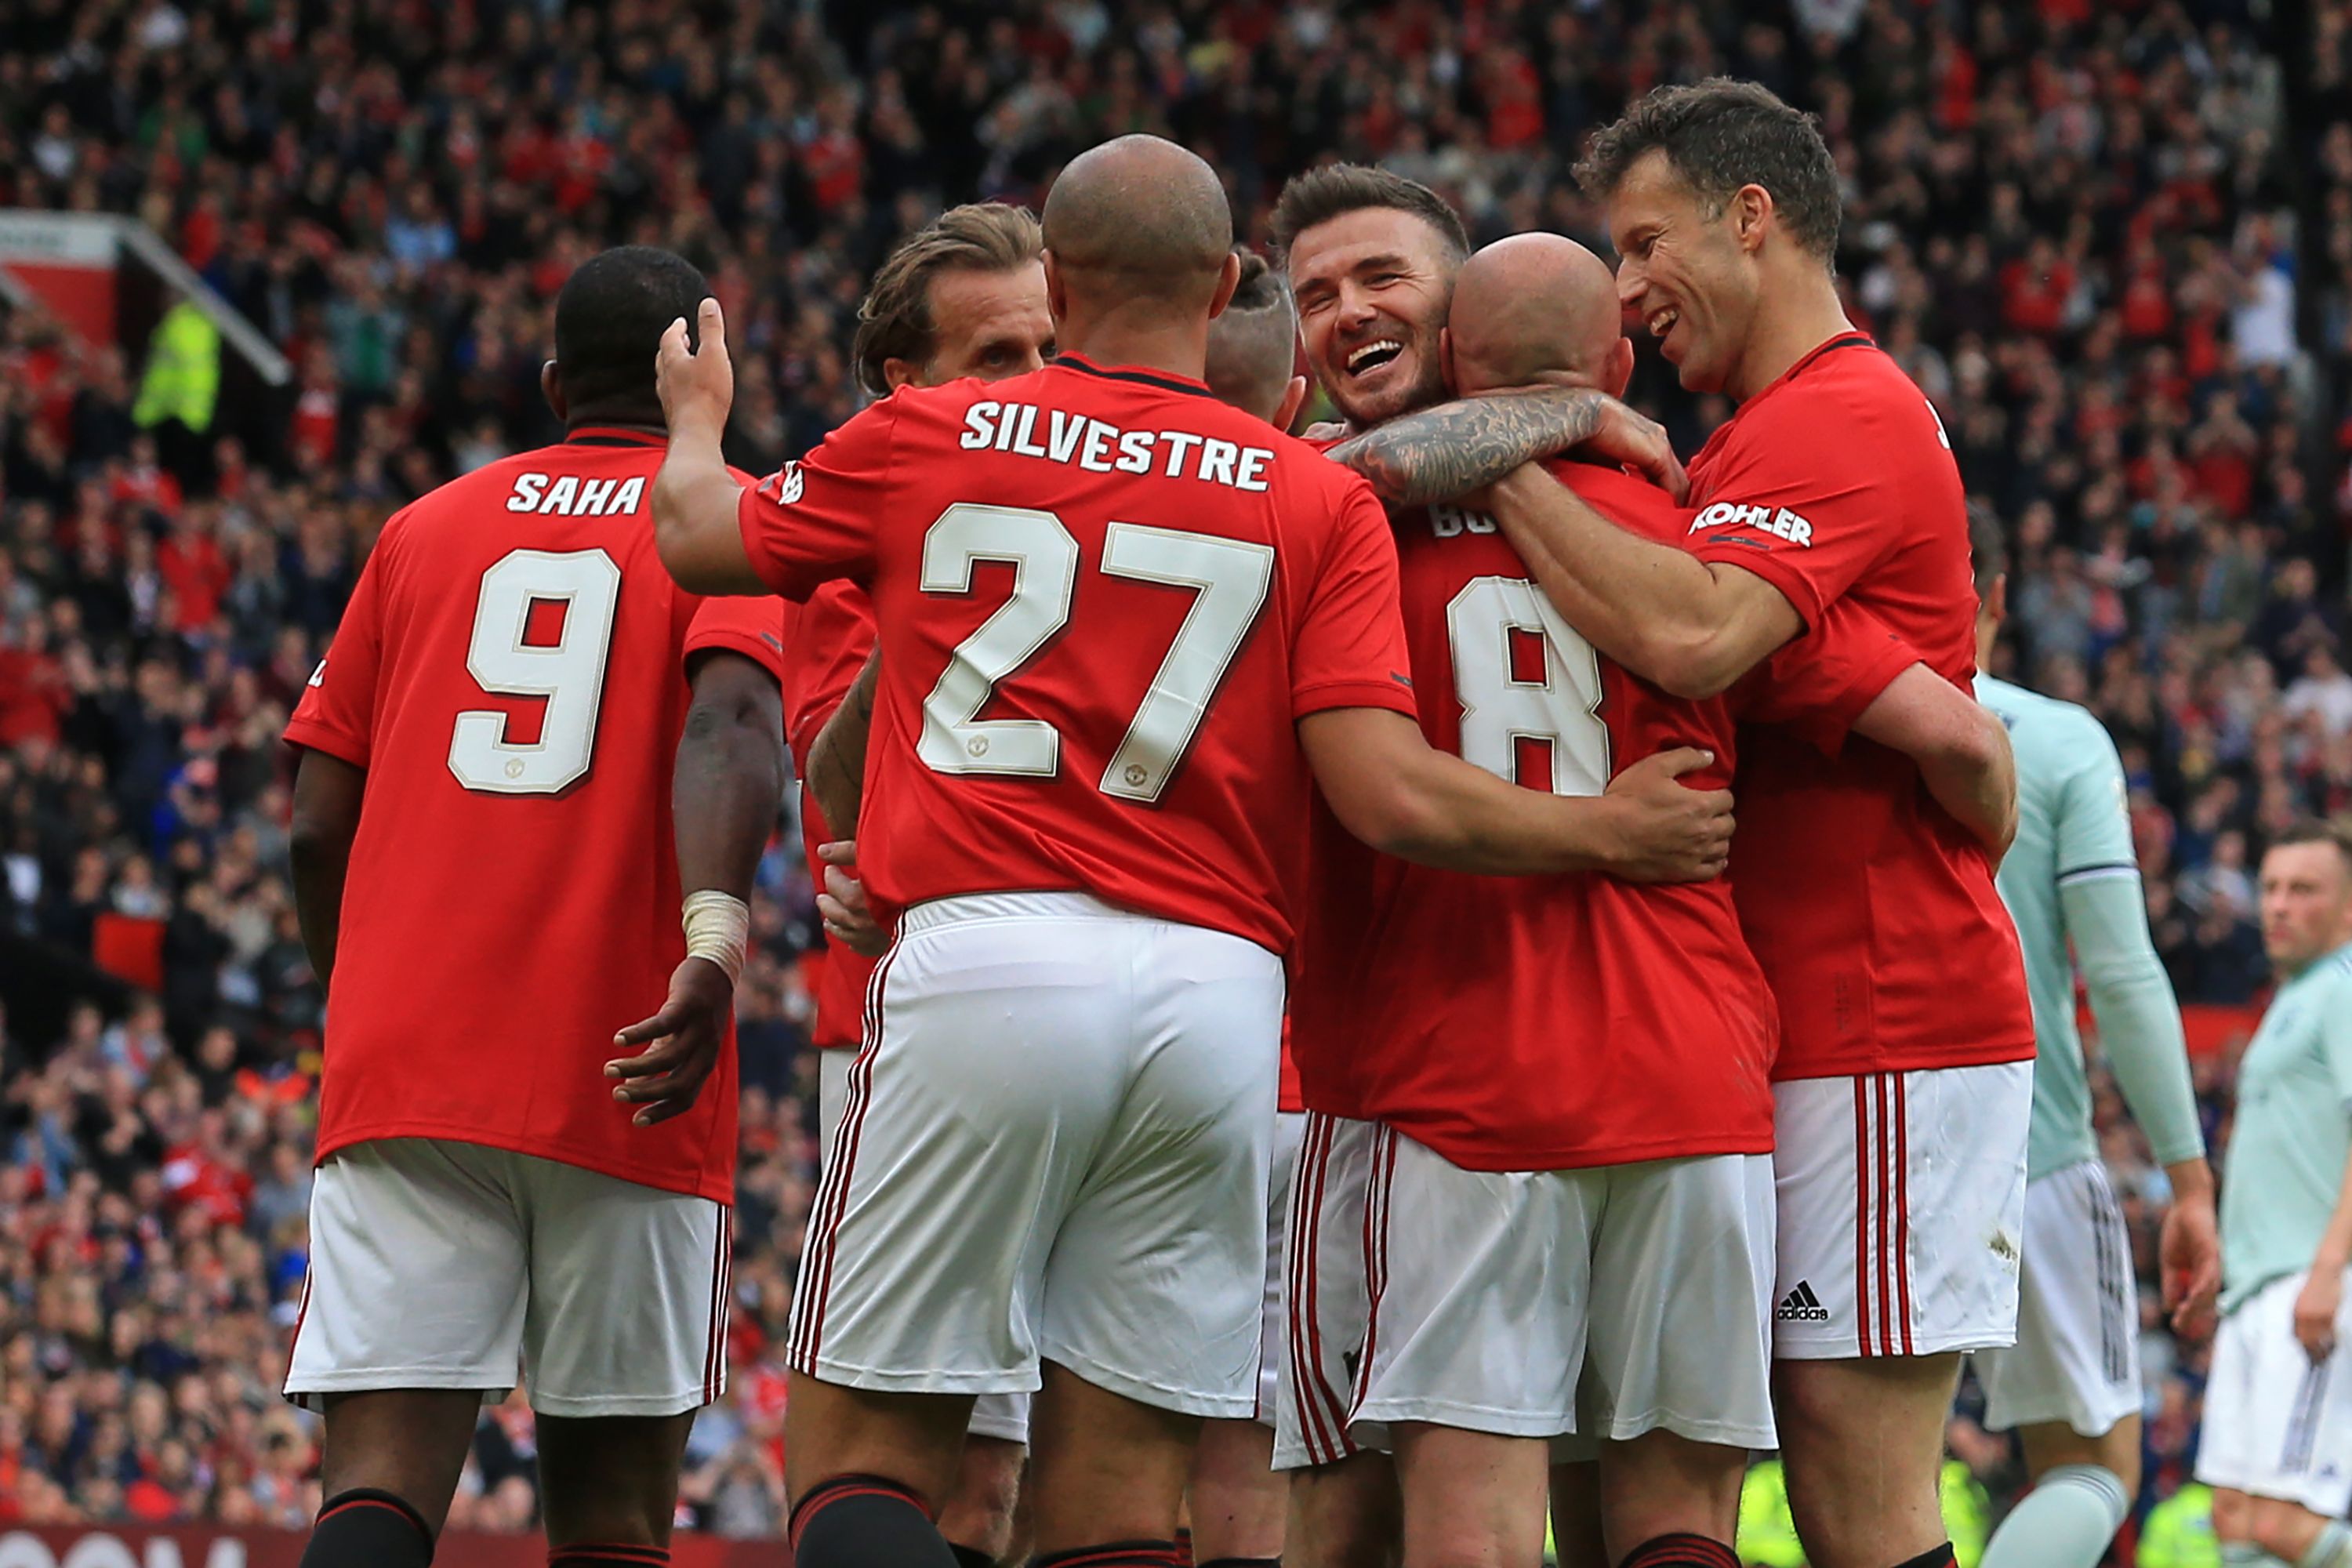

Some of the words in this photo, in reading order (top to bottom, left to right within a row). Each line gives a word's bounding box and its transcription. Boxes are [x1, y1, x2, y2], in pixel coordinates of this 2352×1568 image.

[960, 401, 1275, 492] SILVESTRE
[506, 473, 645, 516] SAHA
[1688, 502, 1813, 548] KOHLER
[447, 548, 622, 793] 9
[916, 503, 1275, 802] 27
[1446, 575, 1611, 797] 8
[1777, 1305, 1828, 1320] adidas
